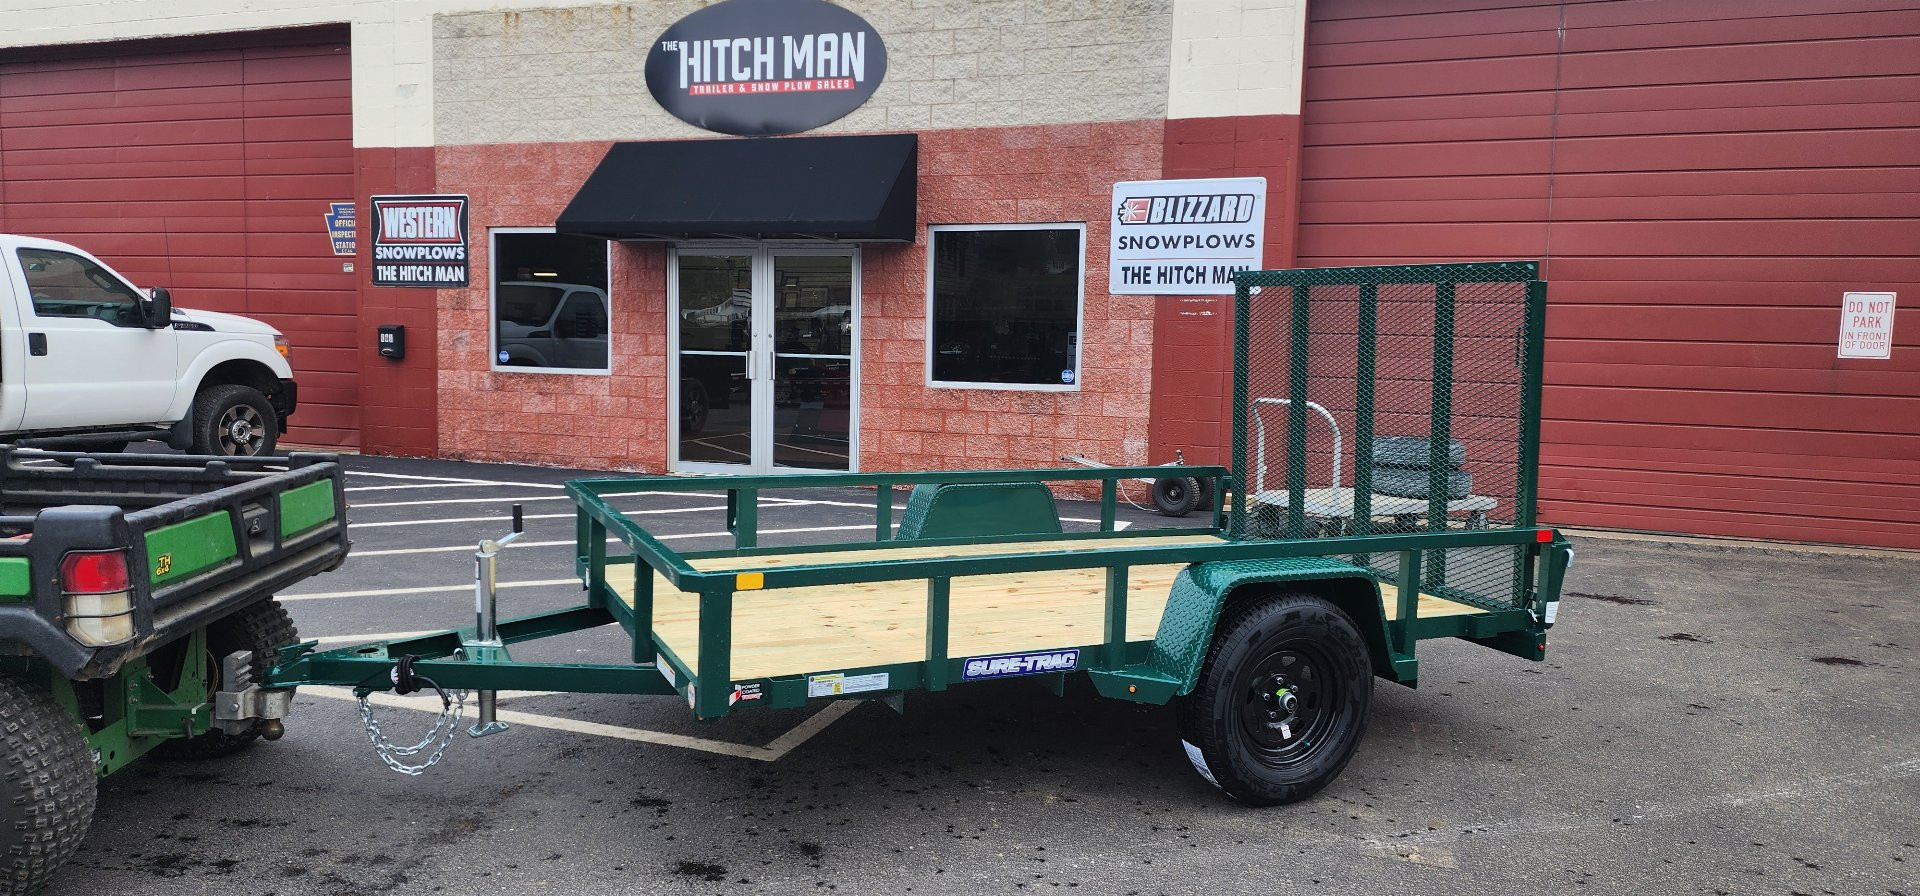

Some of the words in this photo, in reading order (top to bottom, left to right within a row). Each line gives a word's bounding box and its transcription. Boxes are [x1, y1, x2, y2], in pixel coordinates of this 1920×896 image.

[662, 41, 678, 51] THE
[679, 36, 775, 89] HITCH
[783, 31, 865, 82] MAN
[693, 84, 734, 94] TRAILER
[739, 84, 746, 93] &
[751, 82, 779, 92] SNOW
[784, 81, 811, 91] PLOW
[817, 79, 850, 89] SALES
[1150, 195, 1251, 224] BLIZZARD
[334, 219, 356, 227] OFFICI
[382, 206, 456, 239] WESTERN
[335, 241, 356, 249] STATIO
[1118, 234, 1256, 250] SNOWPLOWS
[375, 246, 465, 260] SNOWPLOWS
[376, 265, 397, 282] THE
[400, 265, 432, 282] HITCH
[435, 265, 465, 282] MAN
[1121, 265, 1152, 285] THE
[1157, 265, 1207, 285] HITCH
[1212, 265, 1250, 285] MA
[1848, 301, 1863, 313] DO
[1868, 301, 1891, 314] NOT
[1852, 316, 1882, 329] PARK
[1844, 331, 1854, 340] IN
[1857, 331, 1887, 341] FRONT
[1844, 340, 1857, 349] OF
[1859, 341, 1886, 350] DOOR
[158, 554, 171, 568] TH
[966, 652, 1076, 677] SURE-TRAC
